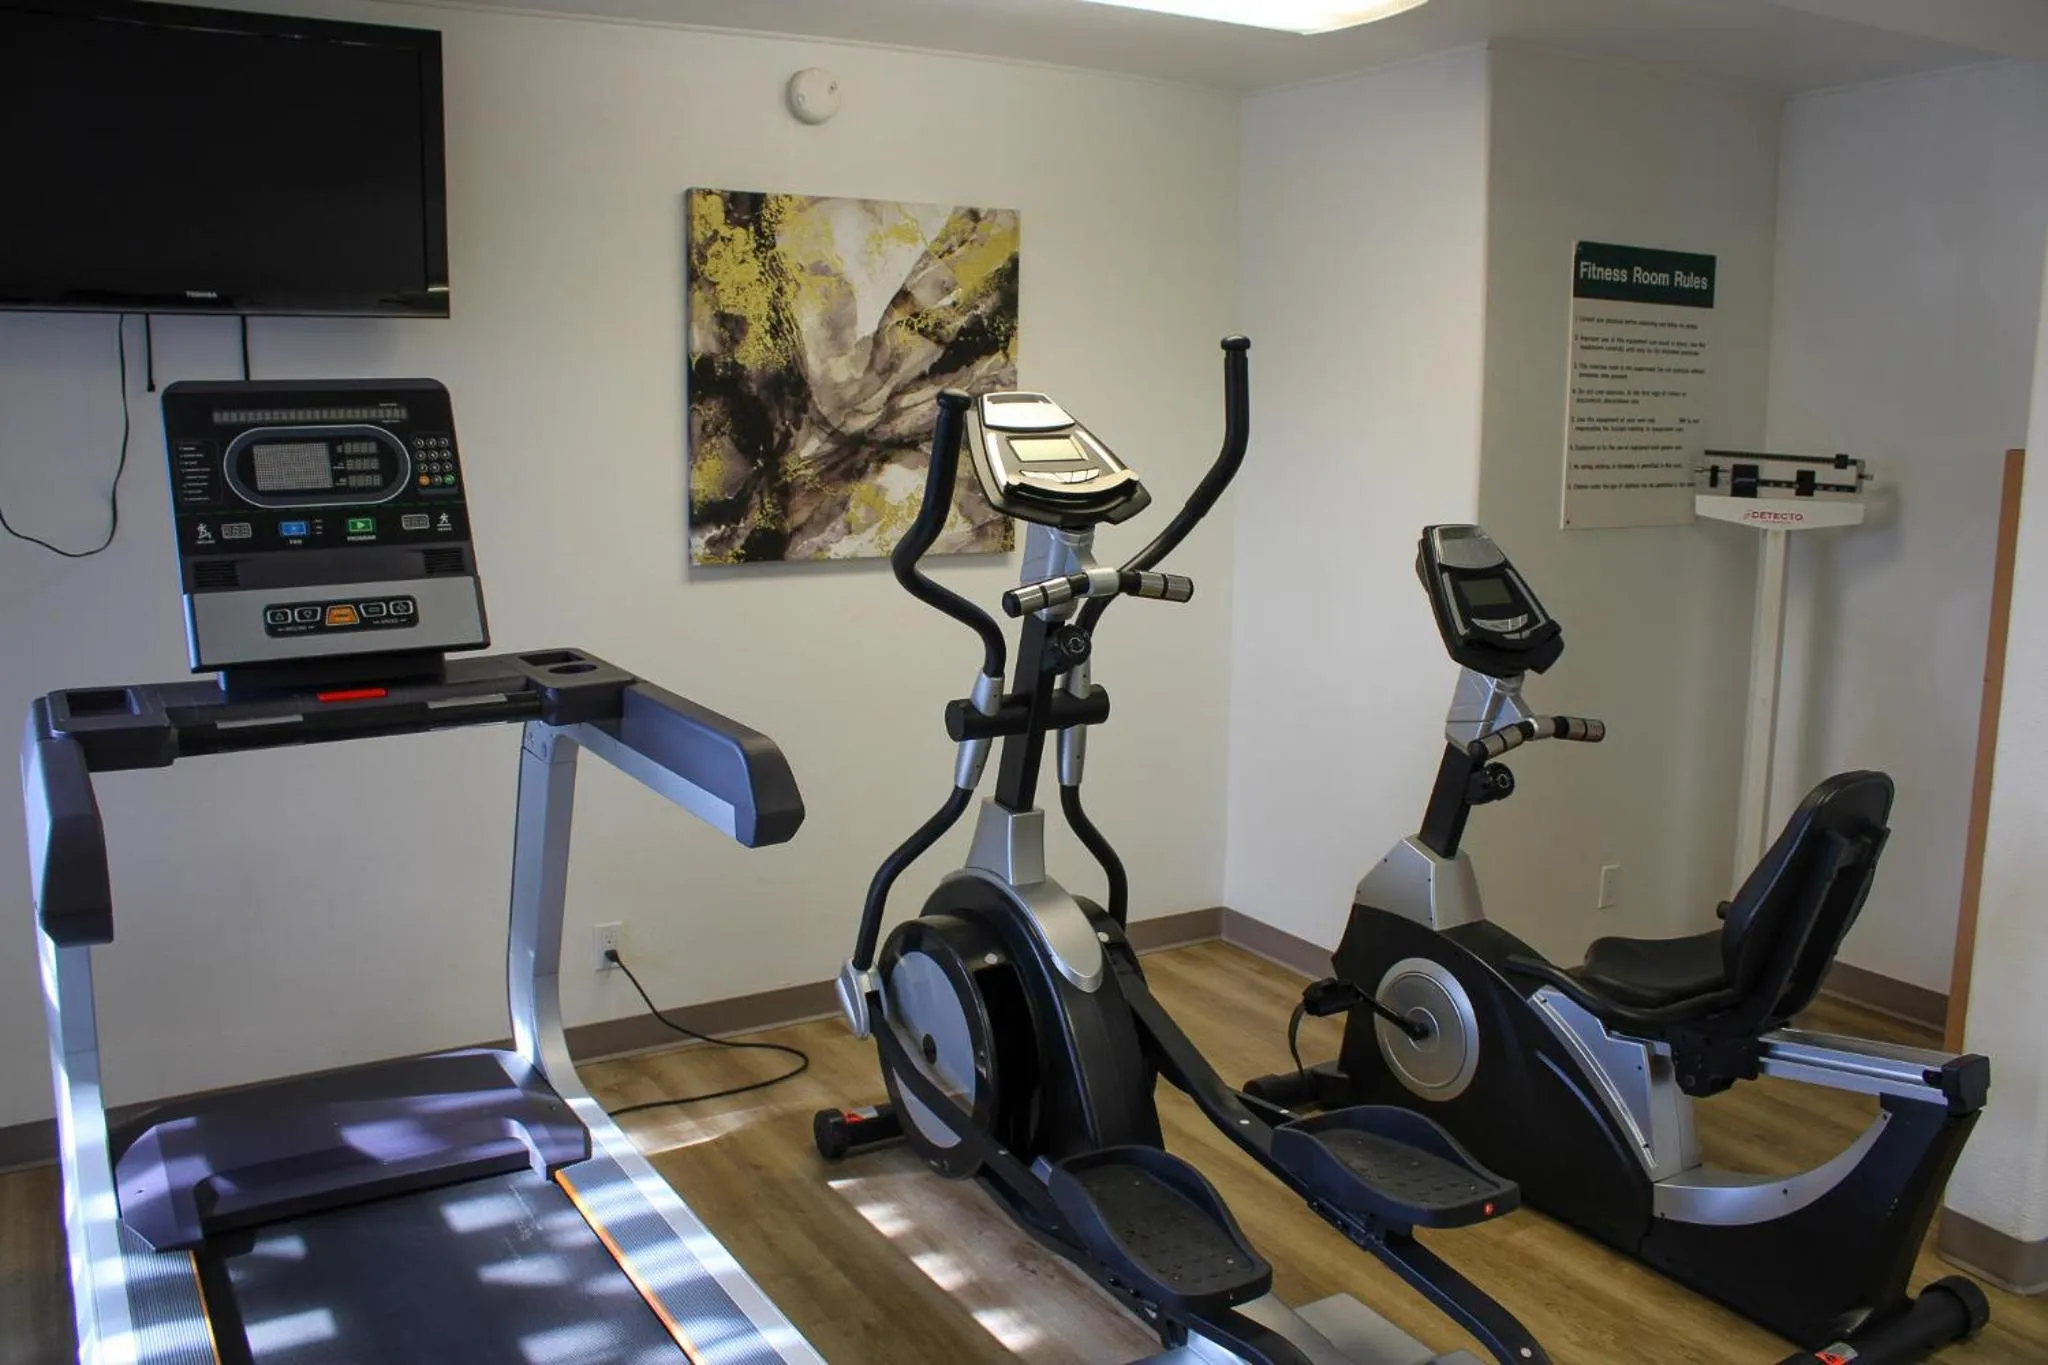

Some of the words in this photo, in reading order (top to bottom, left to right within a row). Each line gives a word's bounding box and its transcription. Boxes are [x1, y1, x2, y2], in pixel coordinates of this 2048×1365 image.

[1579, 261, 1628, 283] Fitness
[1633, 266, 1670, 286] Room
[1674, 271, 1708, 290] Rules
[1752, 511, 1803, 521] DETECTO
